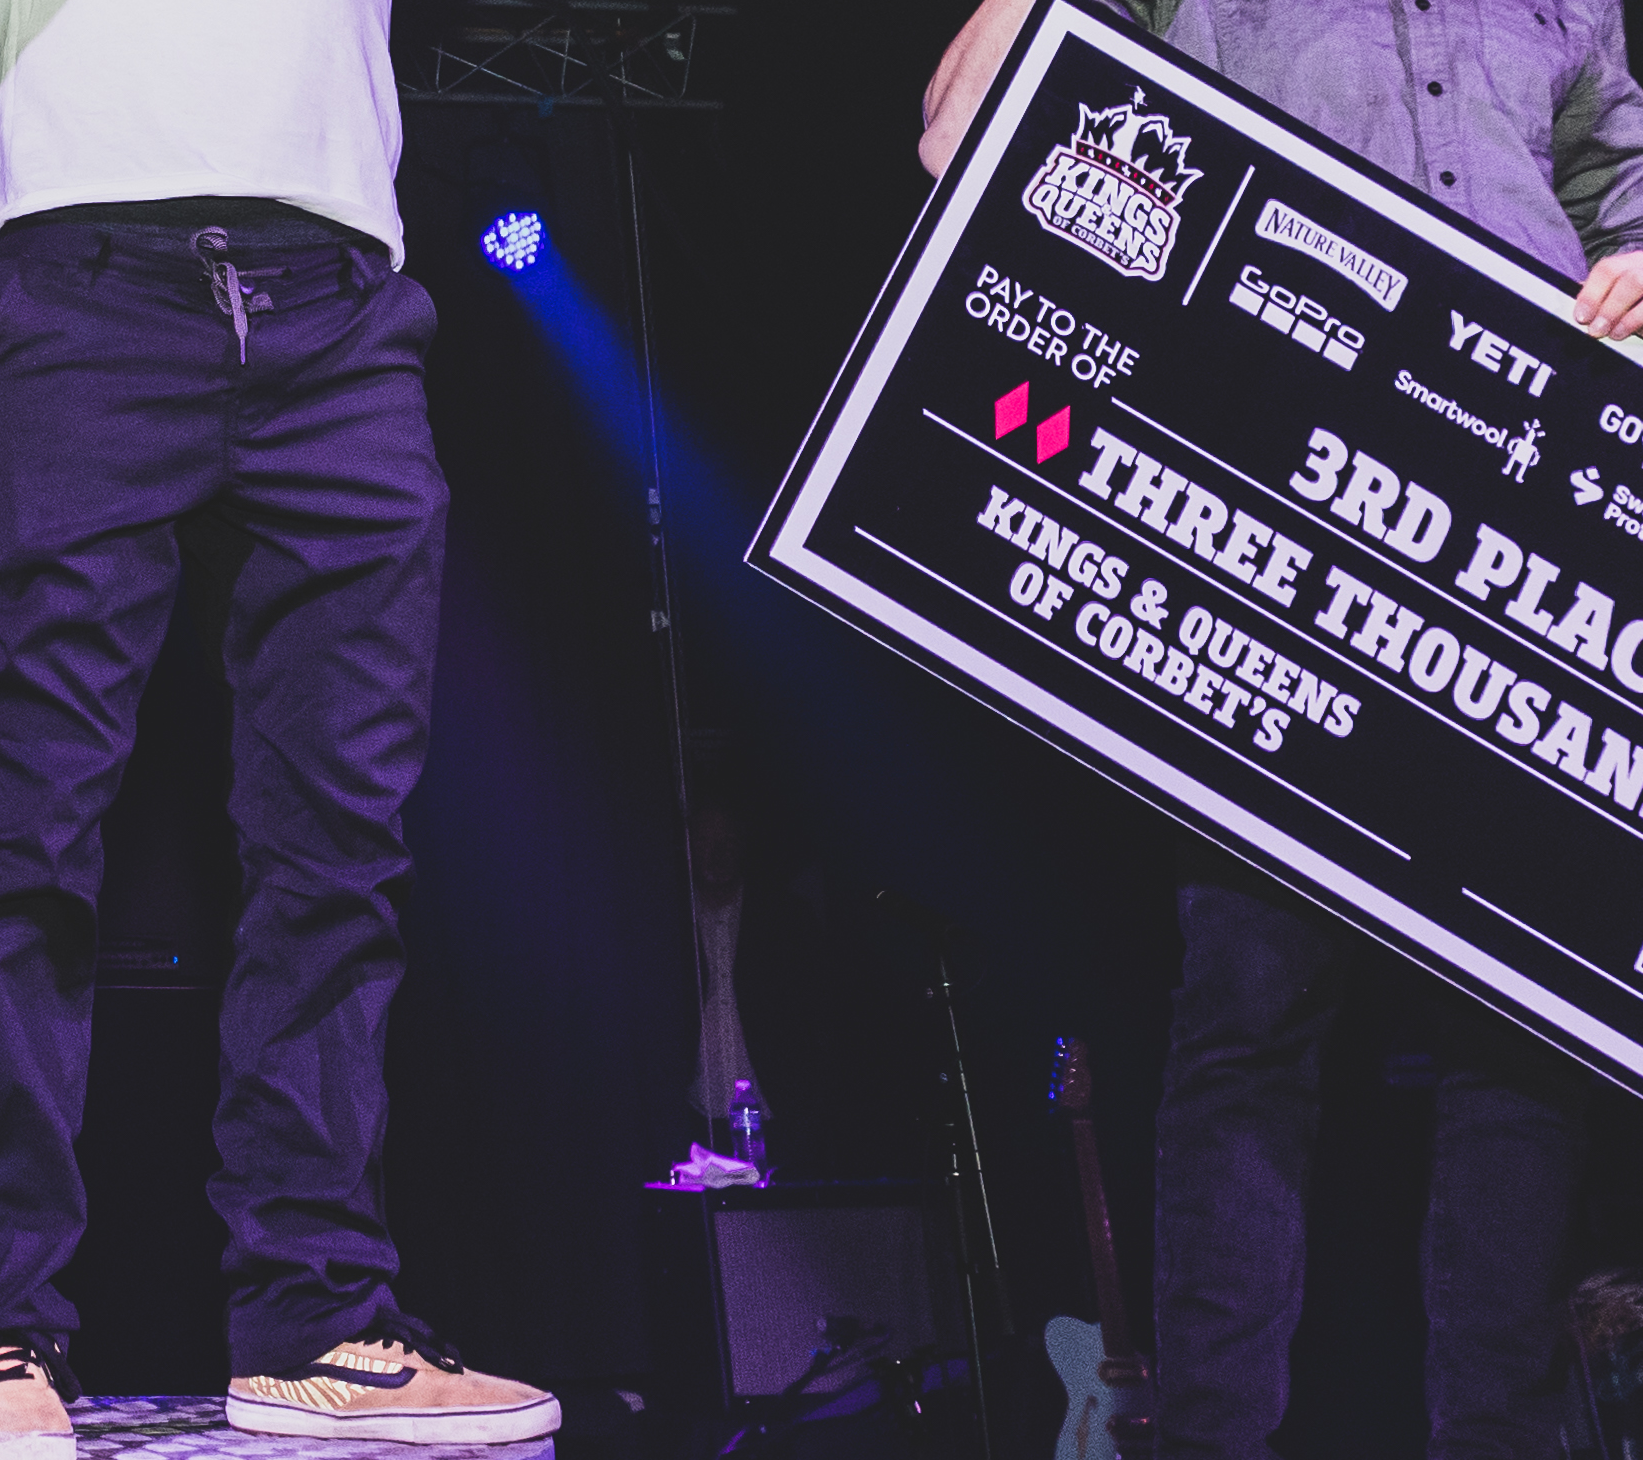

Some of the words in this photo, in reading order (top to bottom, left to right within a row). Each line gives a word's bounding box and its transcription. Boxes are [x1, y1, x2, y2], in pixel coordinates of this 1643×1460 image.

[1032, 184, 1160, 272] QUEENS
[1045, 155, 1171, 246] KINGS
[1052, 216, 1070, 229] OF
[1071, 225, 1130, 266] CORBET'S
[1264, 208, 1338, 258] NATURE
[1340, 247, 1400, 300] VALLEY
[966, 292, 1067, 365] ORDER
[1072, 355, 1116, 388] OF
[977, 265, 1033, 308] PAY
[1037, 296, 1075, 335] TO
[1083, 325, 1139, 375] THE
[1241, 266, 1365, 348] GoPro
[1450, 310, 1552, 397] YETI
[1395, 370, 1508, 447] Smartwool
[1079, 428, 1313, 607] THREE
[1290, 428, 1451, 562] 3RD
[978, 486, 1129, 599] KINGS
[1131, 581, 1168, 629] &
[1179, 607, 1361, 737] QUEENS
[1010, 563, 1074, 620] OF
[1076, 603, 1290, 751] CORBET'S
